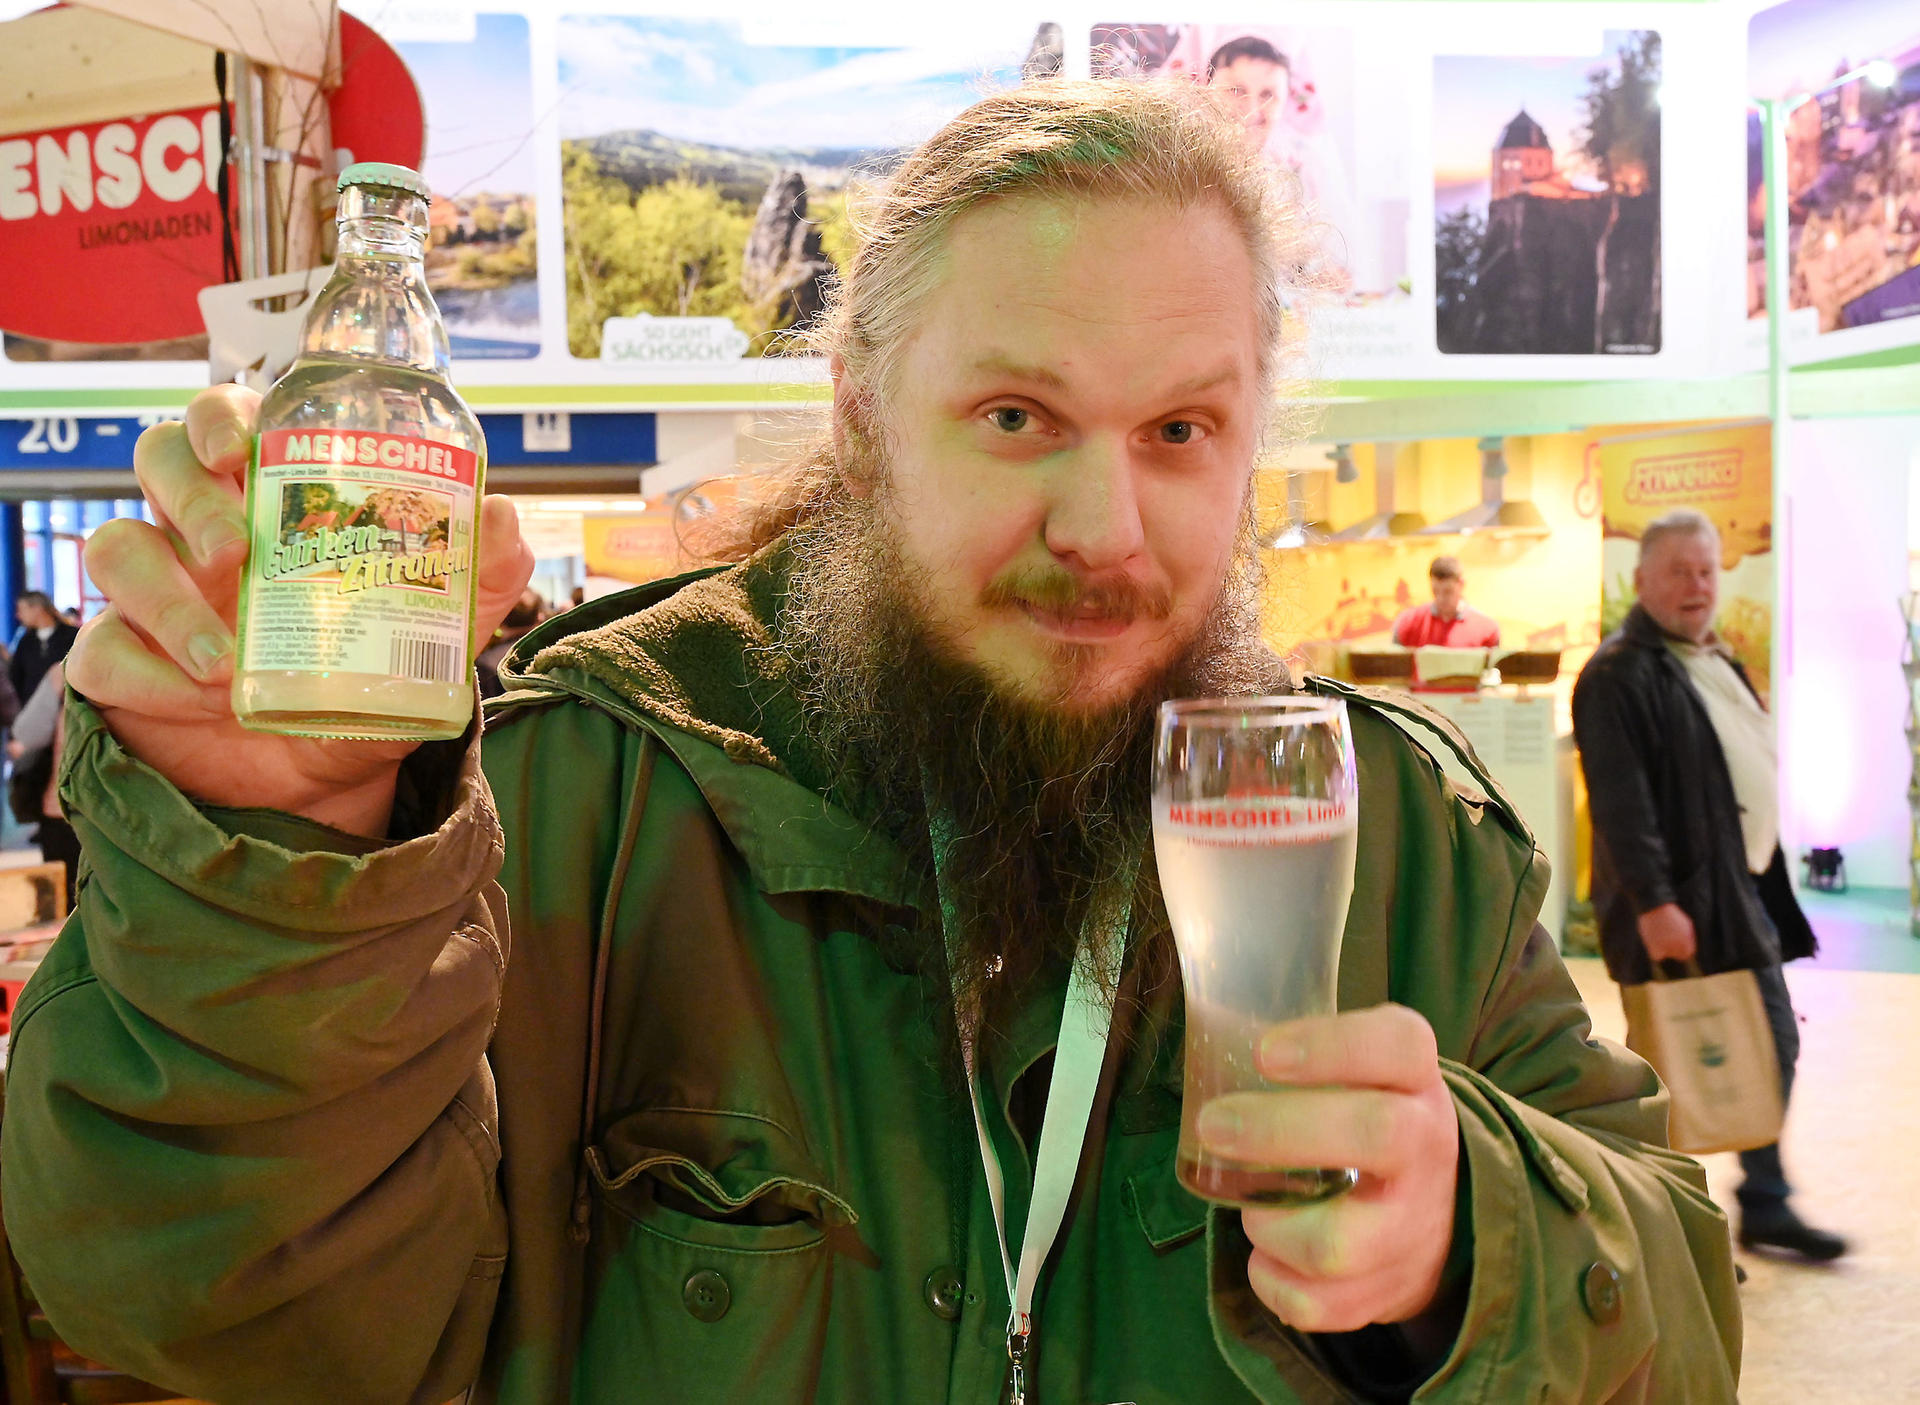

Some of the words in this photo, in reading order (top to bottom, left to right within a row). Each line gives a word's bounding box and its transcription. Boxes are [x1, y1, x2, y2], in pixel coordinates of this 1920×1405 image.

[79, 211, 213, 249] LIMONADEN
[18, 418, 80, 453] 20
[285, 435, 457, 478] MENSCHEL
[264, 525, 402, 579] Gurken-
[337, 547, 469, 594] Zitronen
[404, 593, 463, 614] LIMONADE
[1169, 804, 1295, 829] MENSCHEL
[1307, 800, 1346, 824] Limo
